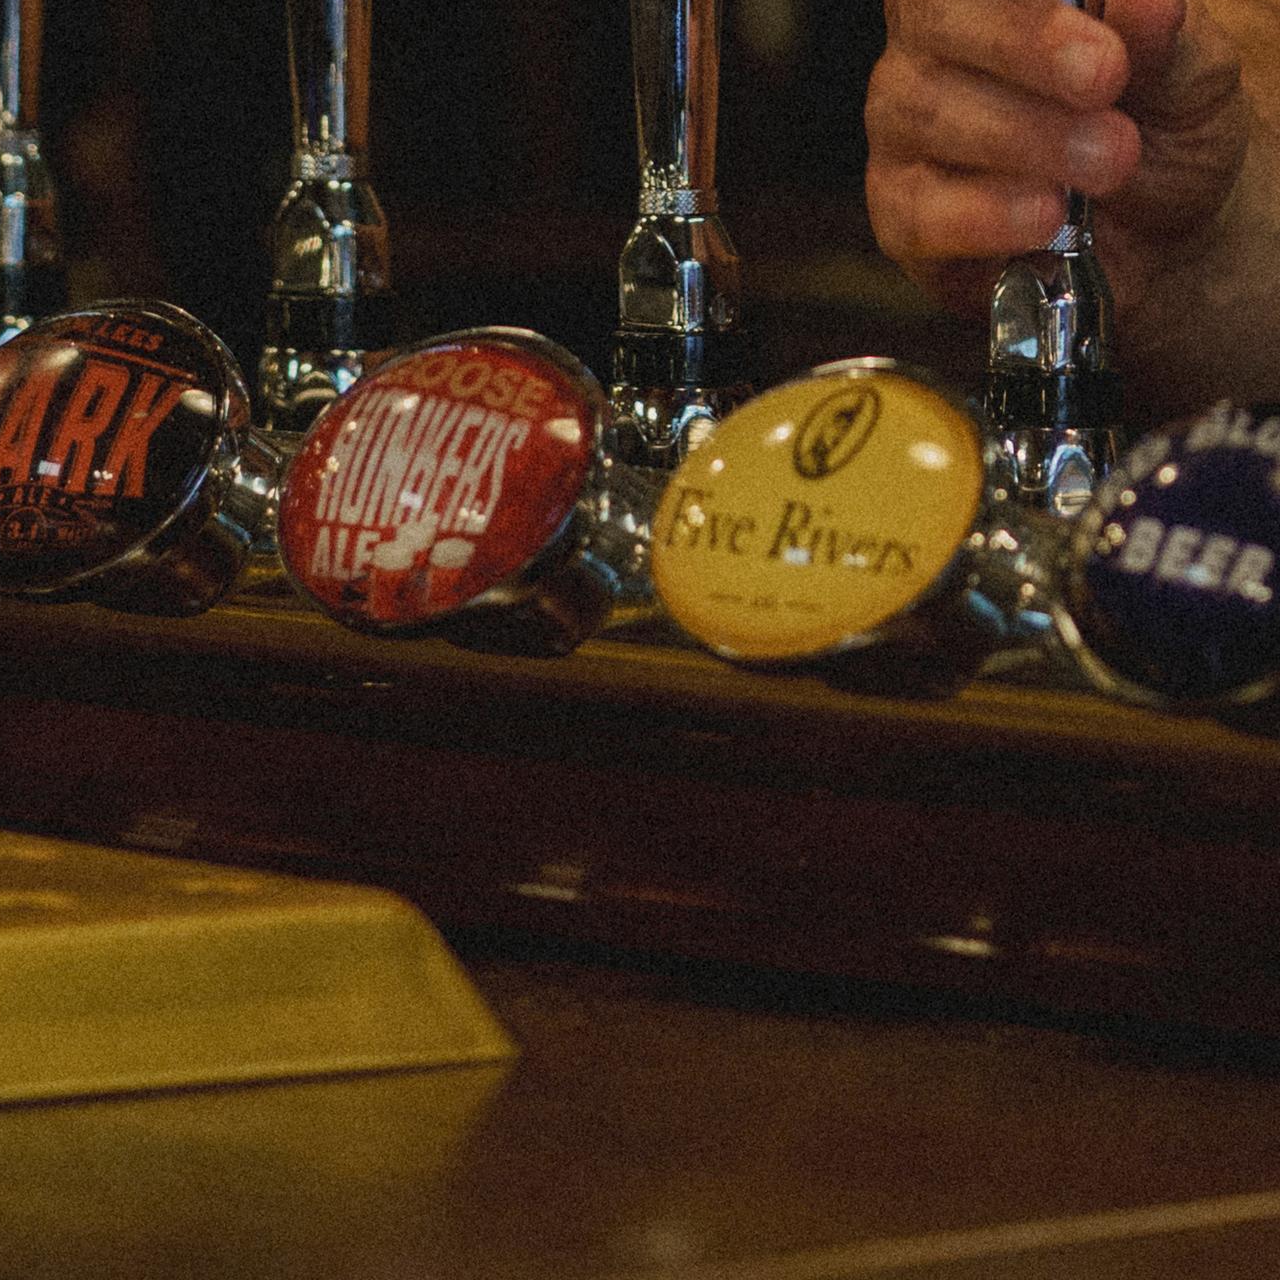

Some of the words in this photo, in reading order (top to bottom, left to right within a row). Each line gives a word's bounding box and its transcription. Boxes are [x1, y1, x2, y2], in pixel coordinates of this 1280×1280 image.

[96, 319, 166, 354] LEES
[316, 388, 531, 535] HONKERS
[311, 526, 382, 582] ALE
[768, 499, 921, 575] Rivers
[1121, 514, 1275, 604] BEER
